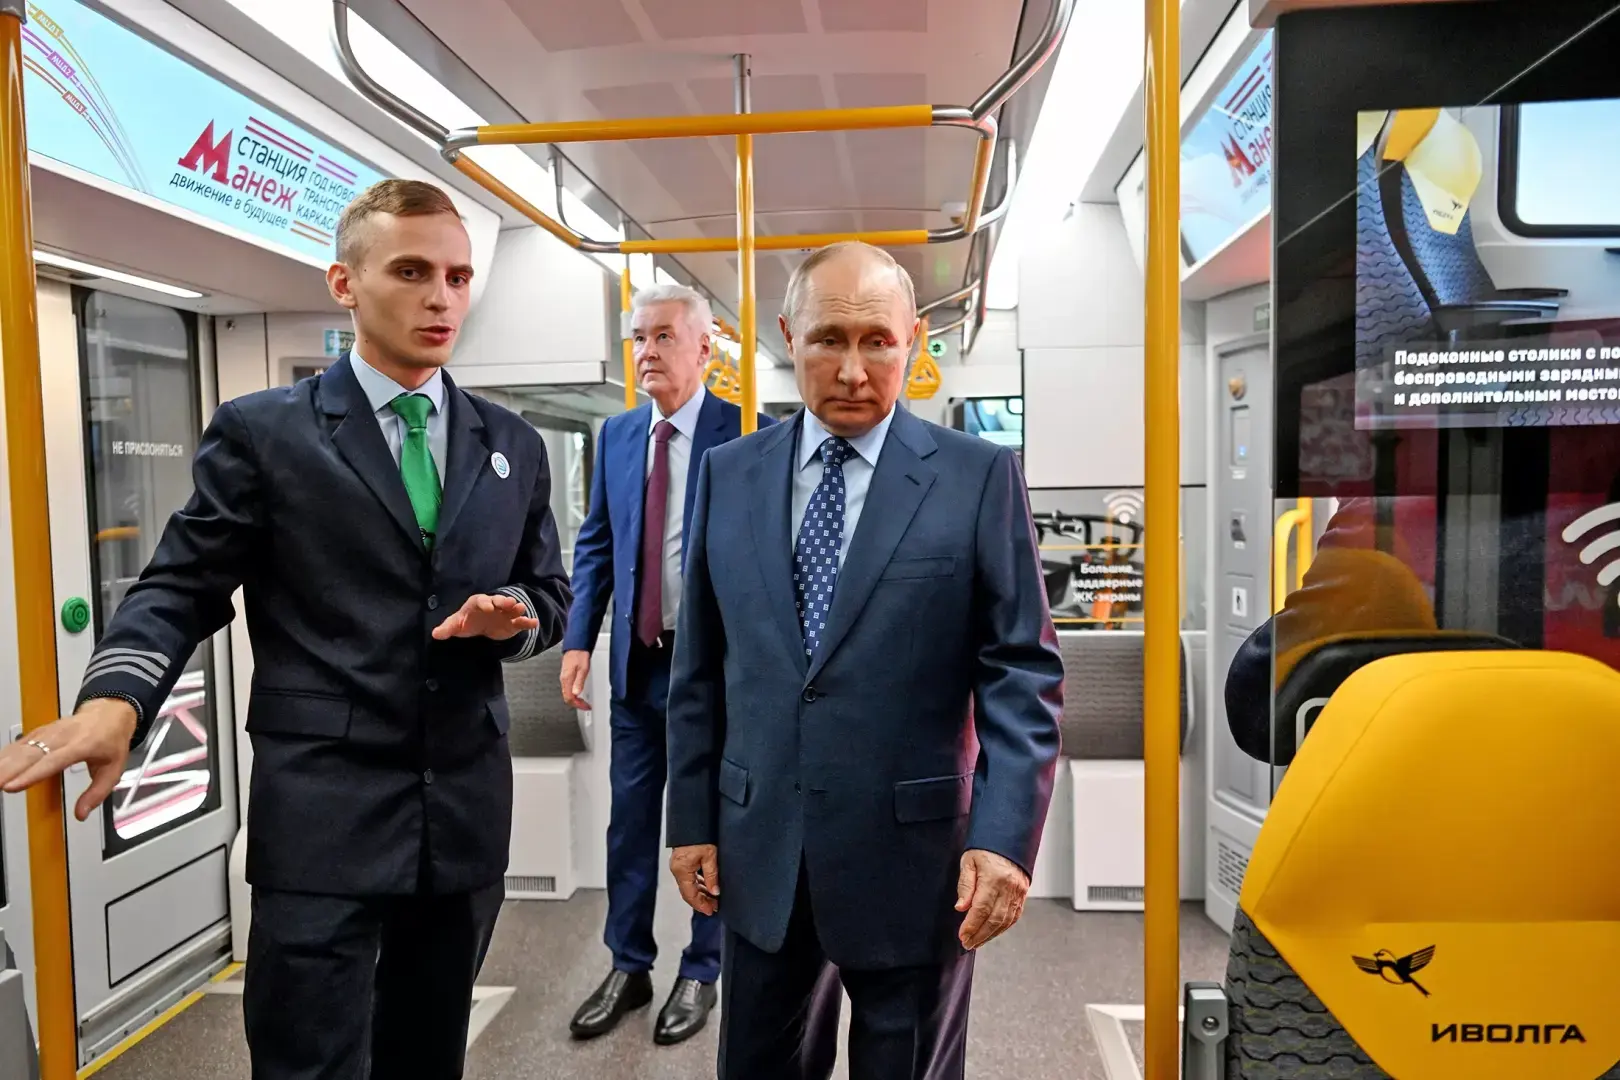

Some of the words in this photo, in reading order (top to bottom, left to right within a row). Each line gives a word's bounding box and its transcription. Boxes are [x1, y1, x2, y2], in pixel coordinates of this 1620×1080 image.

[177, 118, 298, 212] Манеж
[309, 171, 329, 191] ГОД
[169, 172, 233, 206] движение
[233, 199, 242, 210] в
[243, 199, 288, 229] будущее
[1394, 350, 1505, 366] Подоконные
[1508, 348, 1581, 362] столики
[1585, 347, 1596, 360] с
[1600, 346, 1620, 360] по
[1394, 370, 1536, 387] беспроводными
[1539, 367, 1620, 384] зарядны
[1393, 393, 1406, 405] и
[1408, 389, 1561, 407] дополнительным
[1565, 387, 1620, 401] место
[112, 441, 124, 454] НЕ
[124, 441, 183, 457] ПРИСЛОНЯТЬСЯ
[1080, 563, 1133, 574] Большие
[1431, 1023, 1587, 1044] ИВОЛГА
